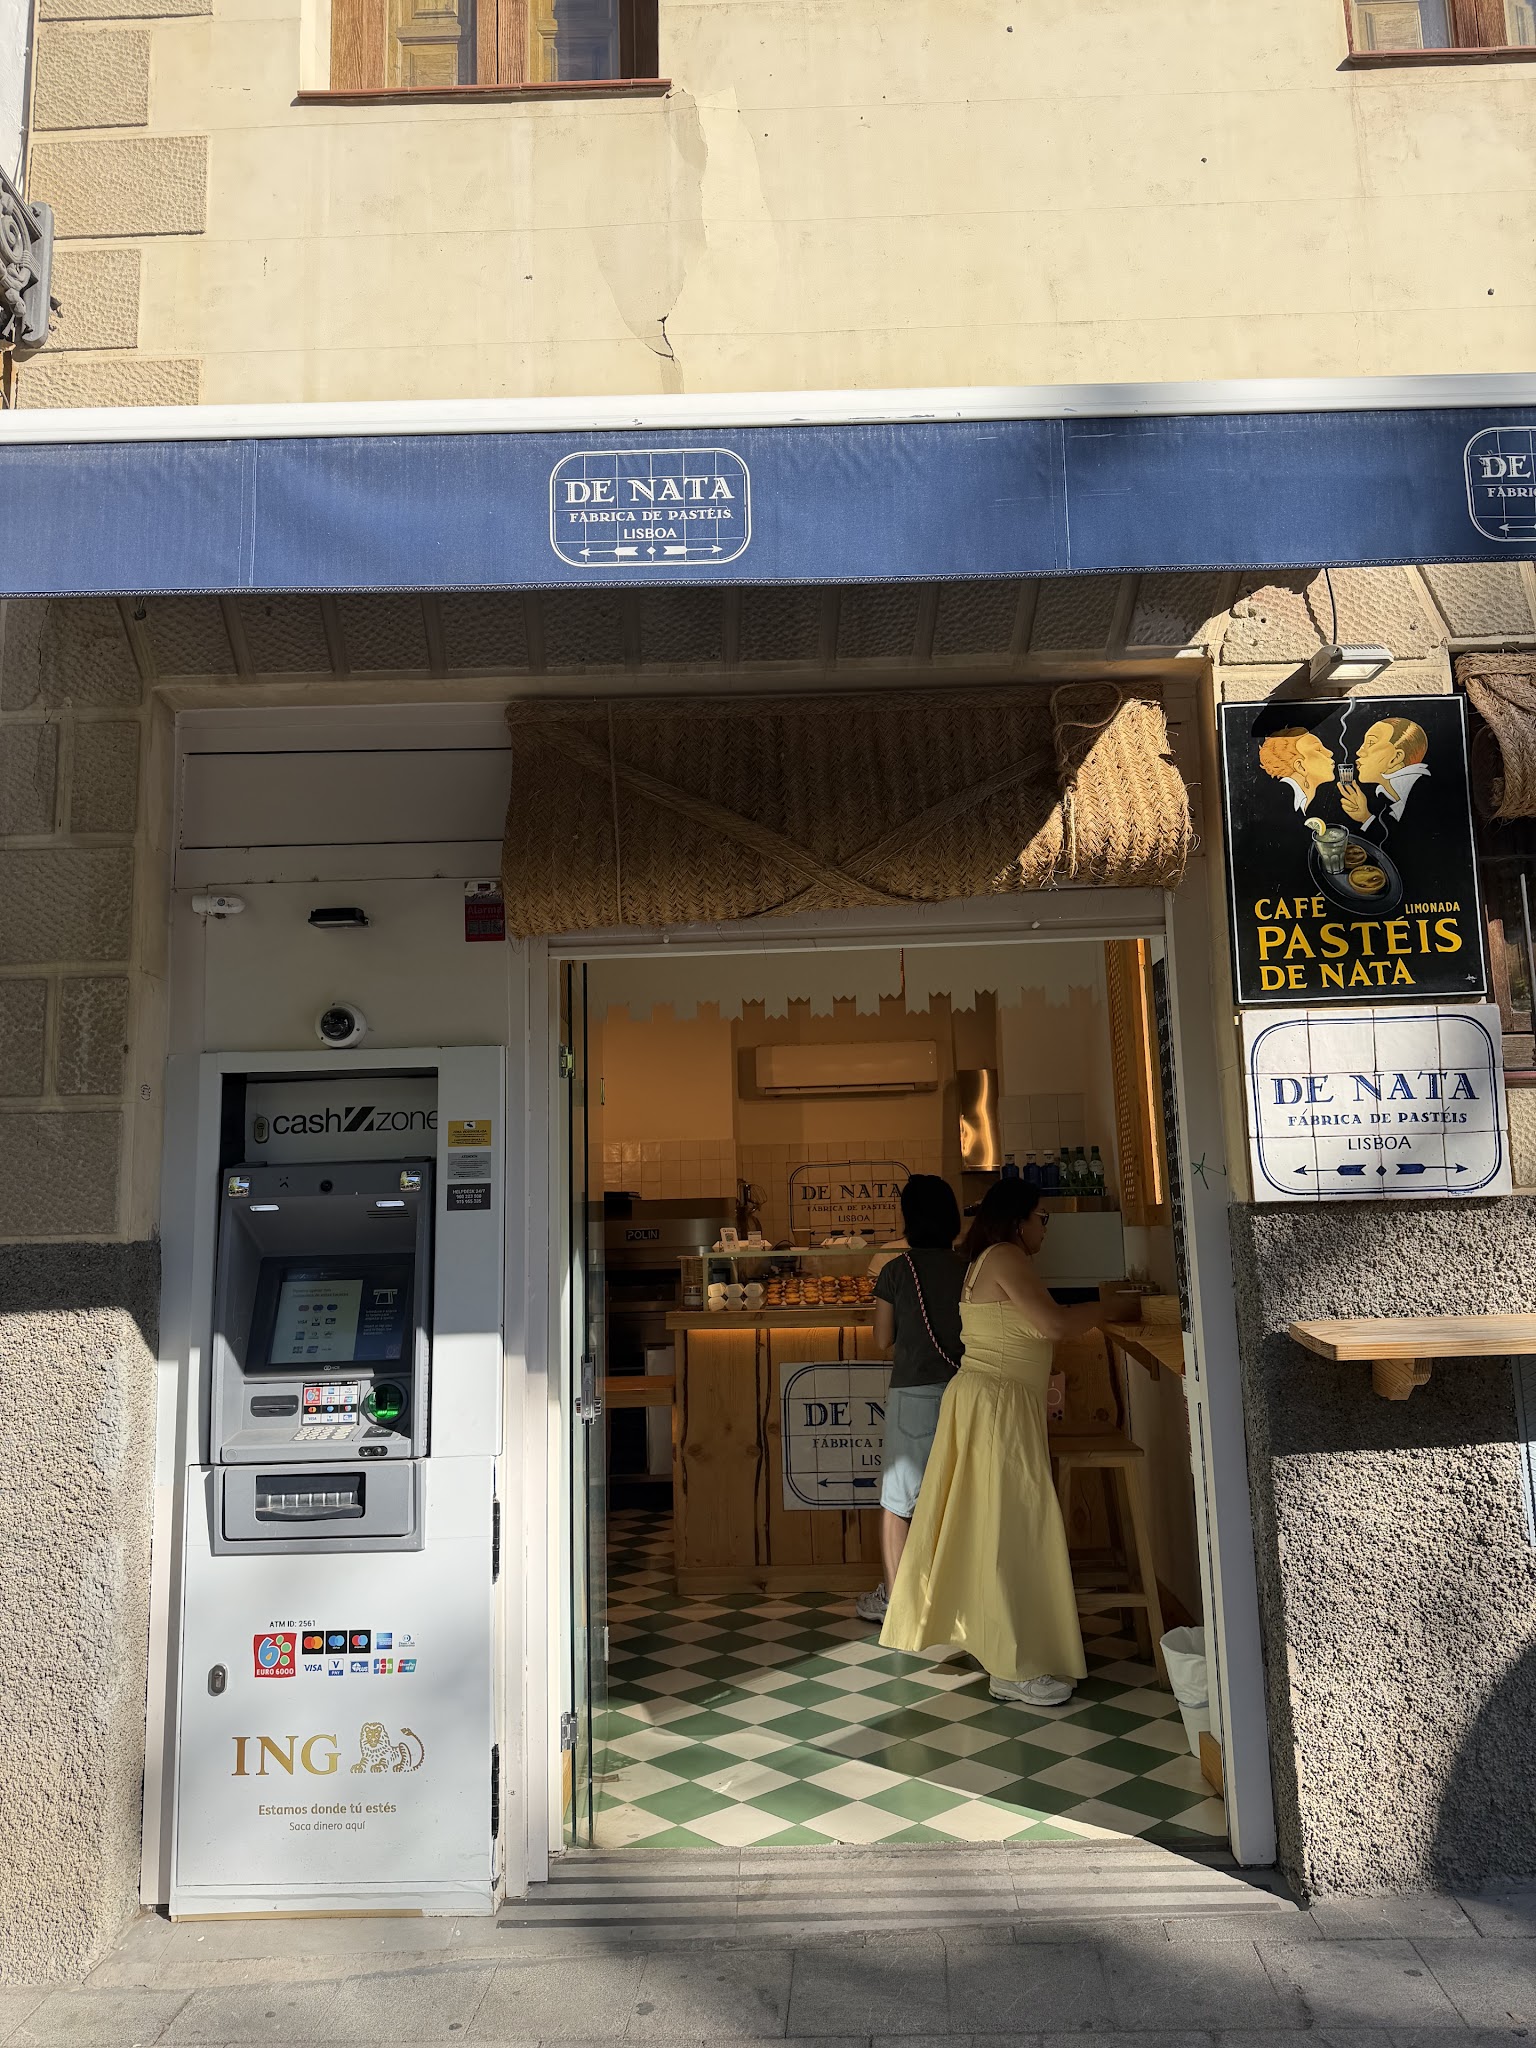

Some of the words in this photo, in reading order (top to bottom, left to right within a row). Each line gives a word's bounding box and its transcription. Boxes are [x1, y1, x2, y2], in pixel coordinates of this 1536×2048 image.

[1480, 455, 1531, 478] DE
[565, 479, 615, 503] DE
[627, 477, 735, 501] NATA
[642, 510, 662, 521] DE
[668, 508, 732, 520] PASTÉIS
[623, 527, 677, 539] LISBOA
[1254, 892, 1327, 920] CAFÉ
[1405, 901, 1461, 915] LIMONADA
[1257, 916, 1463, 961] PASTÉIS
[1259, 964, 1307, 991] DE
[1319, 957, 1416, 990] NATA
[1270, 1075, 1334, 1105] DE
[1349, 1071, 1480, 1102] NATA
[1288, 1108, 1362, 1127] FÁBRICA
[1370, 1112, 1392, 1124] DE
[1400, 1106, 1468, 1124] PASTÉIS
[1348, 1135, 1412, 1151] LISBOA
[801, 1185, 831, 1200] DE
[839, 1183, 903, 1199] NATA
[838, 1214, 870, 1222] LISBOA
[627, 1230, 658, 1240] POLIN
[803, 1402, 852, 1427] DE
[812, 1434, 873, 1448] FÁBRICA
[304, 1664, 323, 1672] VISA
[231, 1734, 341, 1776] ING
[258, 1804, 308, 1816] Estamos
[311, 1803, 347, 1815] donde
[350, 1802, 362, 1814] tú
[366, 1801, 397, 1814] estés
[289, 1822, 311, 1831] Saca
[313, 1821, 343, 1830] dinero
[345, 1820, 366, 1832] aquí
